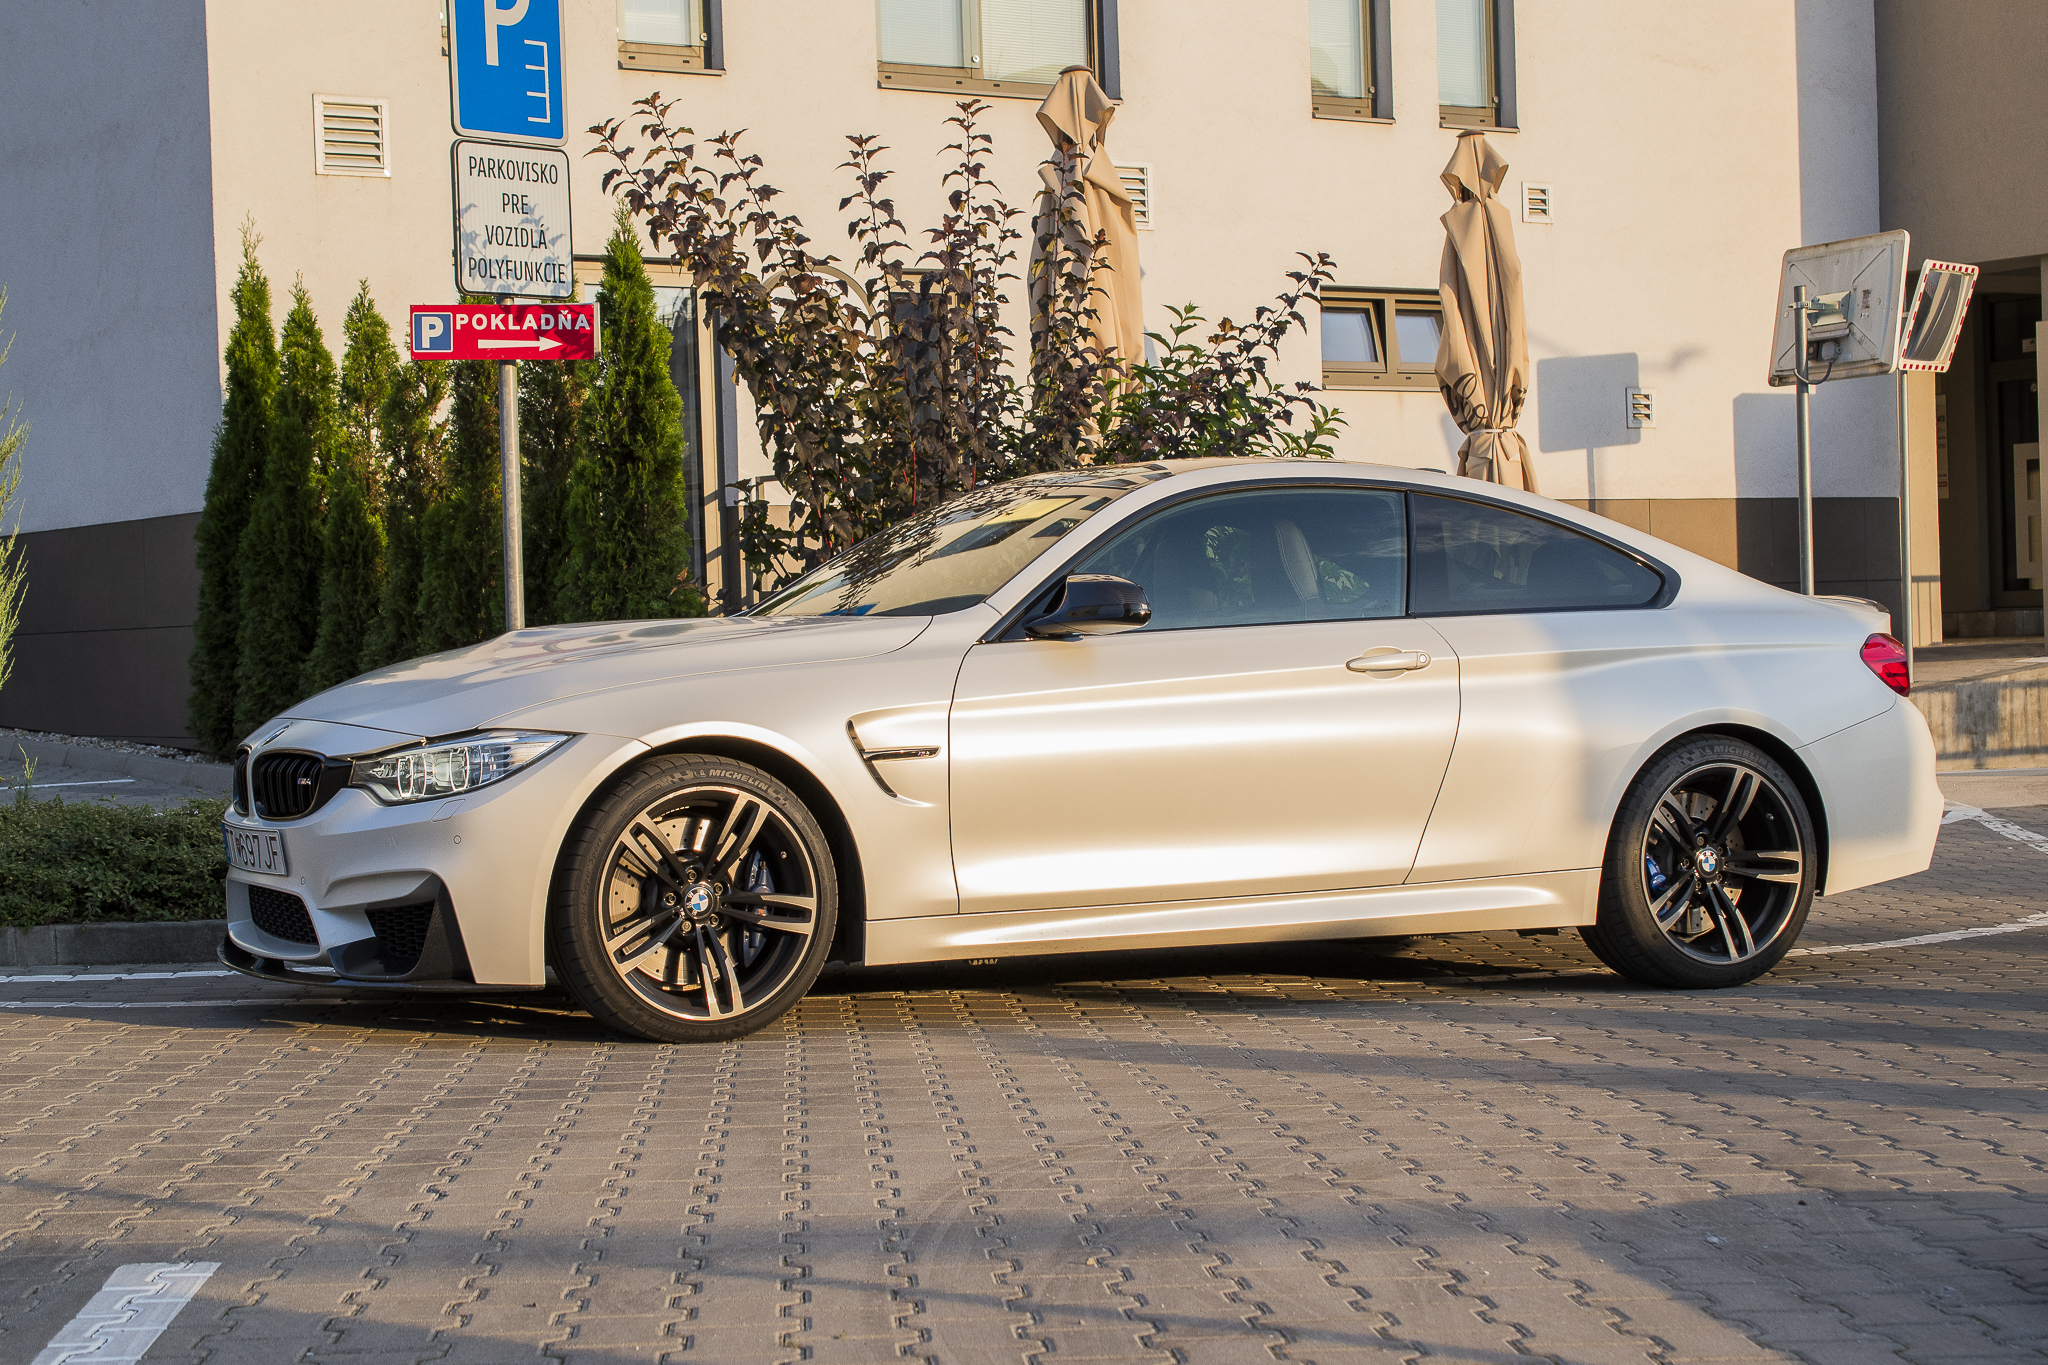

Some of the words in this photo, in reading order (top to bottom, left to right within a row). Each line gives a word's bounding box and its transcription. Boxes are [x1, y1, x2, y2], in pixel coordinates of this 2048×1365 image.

[468, 155, 559, 185] PARKOVISKO
[502, 192, 529, 215] PRE
[484, 223, 548, 250] VOZIDLÁ
[468, 256, 566, 284] POLYFUNKCIE
[421, 316, 444, 349] P
[455, 309, 591, 331] POKLADŇA
[1713, 745, 1770, 766] MICHELIN
[708, 769, 769, 791] MICHELIN
[239, 831, 262, 868] 697
[264, 834, 278, 870] JF
